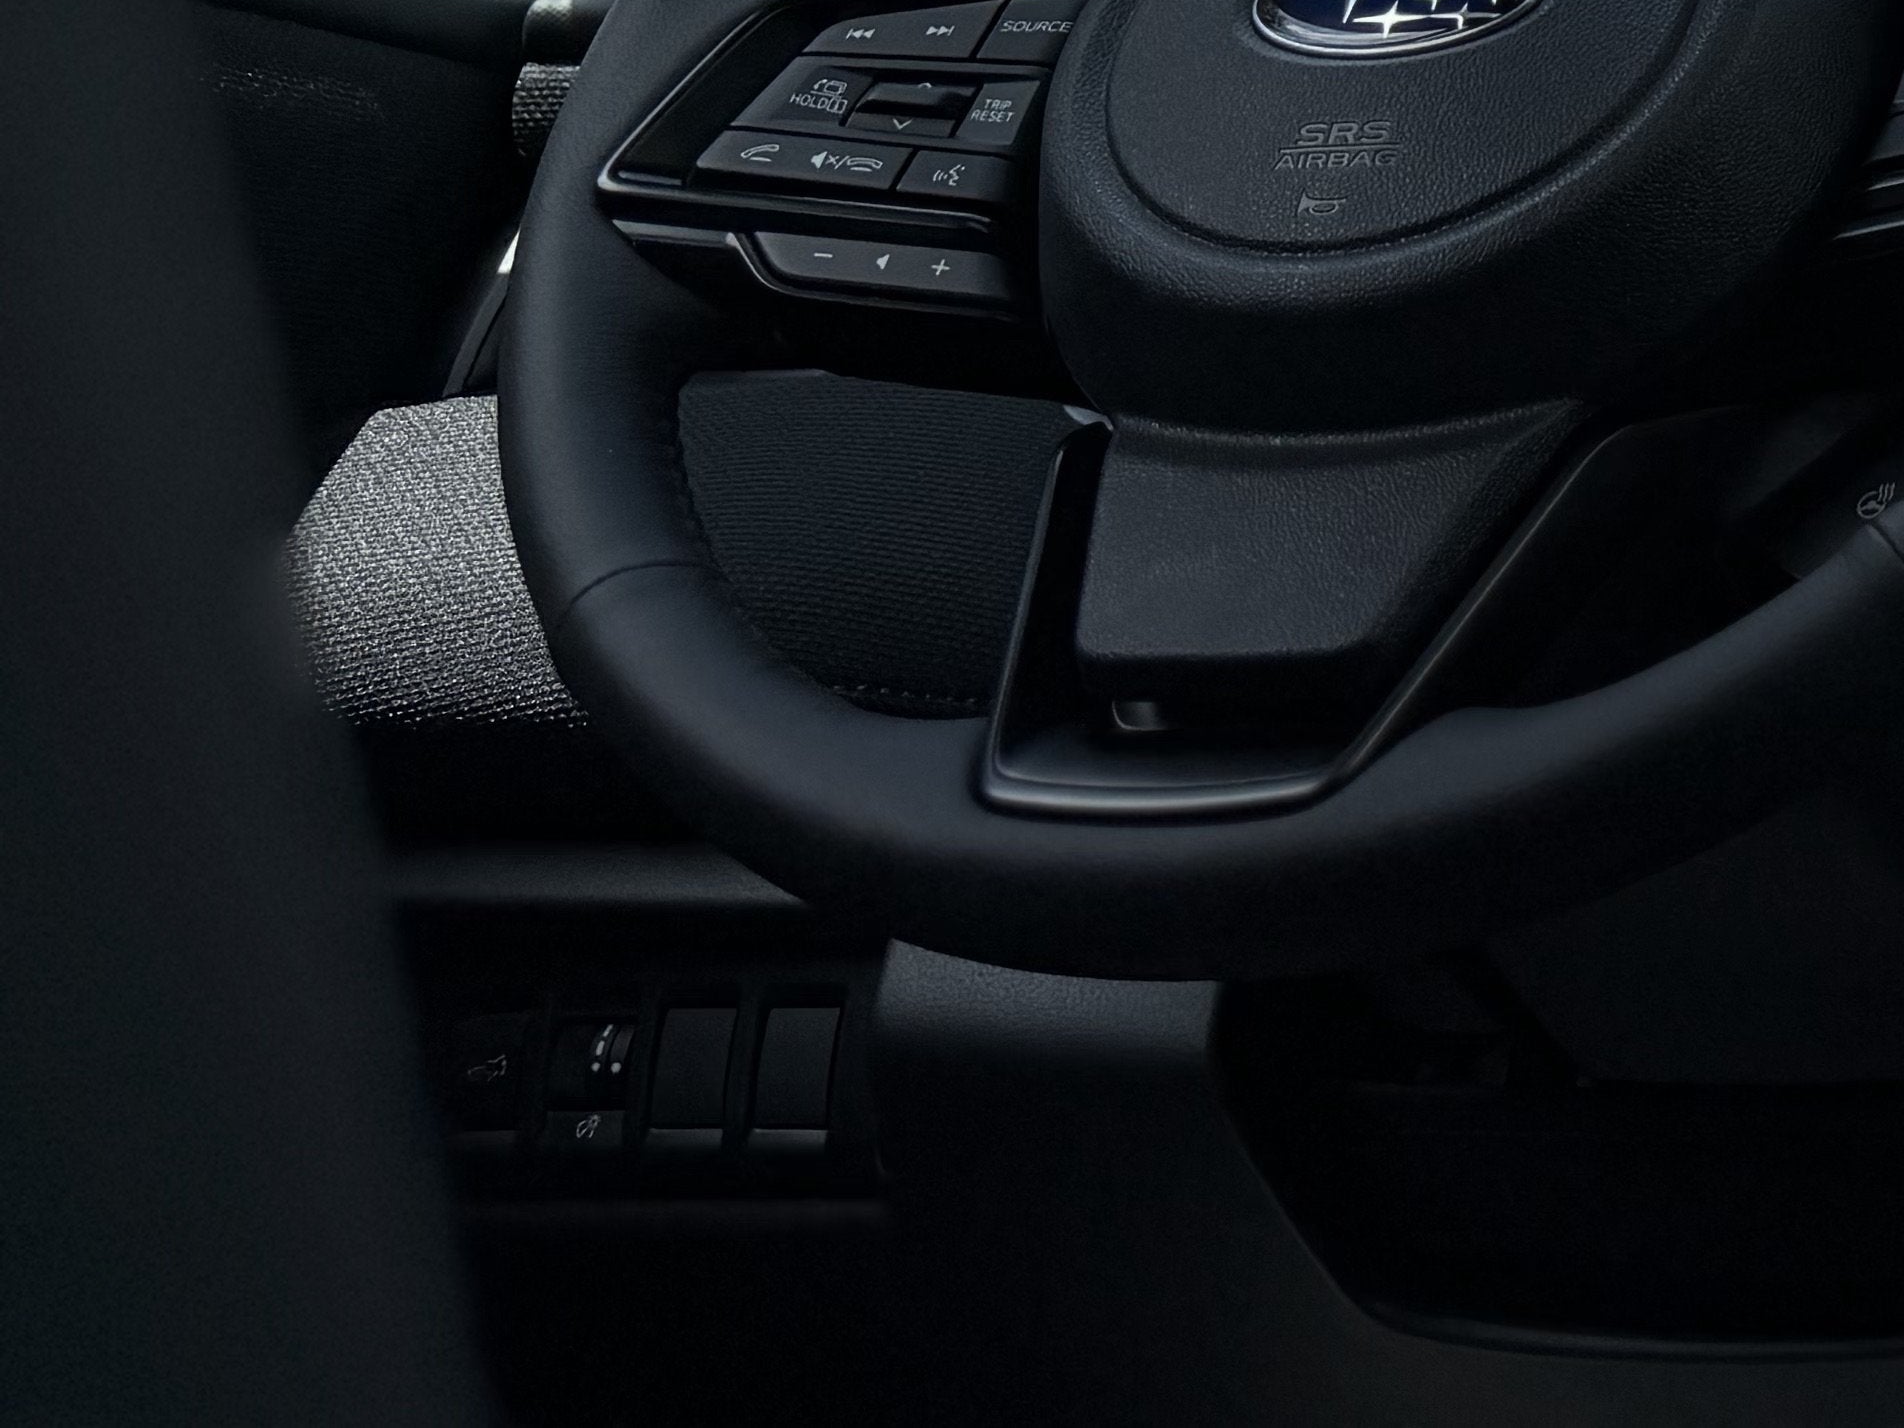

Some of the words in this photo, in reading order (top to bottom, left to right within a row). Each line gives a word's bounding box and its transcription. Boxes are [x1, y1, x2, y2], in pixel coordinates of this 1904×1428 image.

[1000, 18, 1073, 34] SOURCE
[789, 92, 829, 110] HOLD
[982, 97, 1013, 111] TRIP
[970, 109, 1014, 124] RESET
[1294, 119, 1393, 146] SRS
[1272, 148, 1400, 171] AIRBAG
